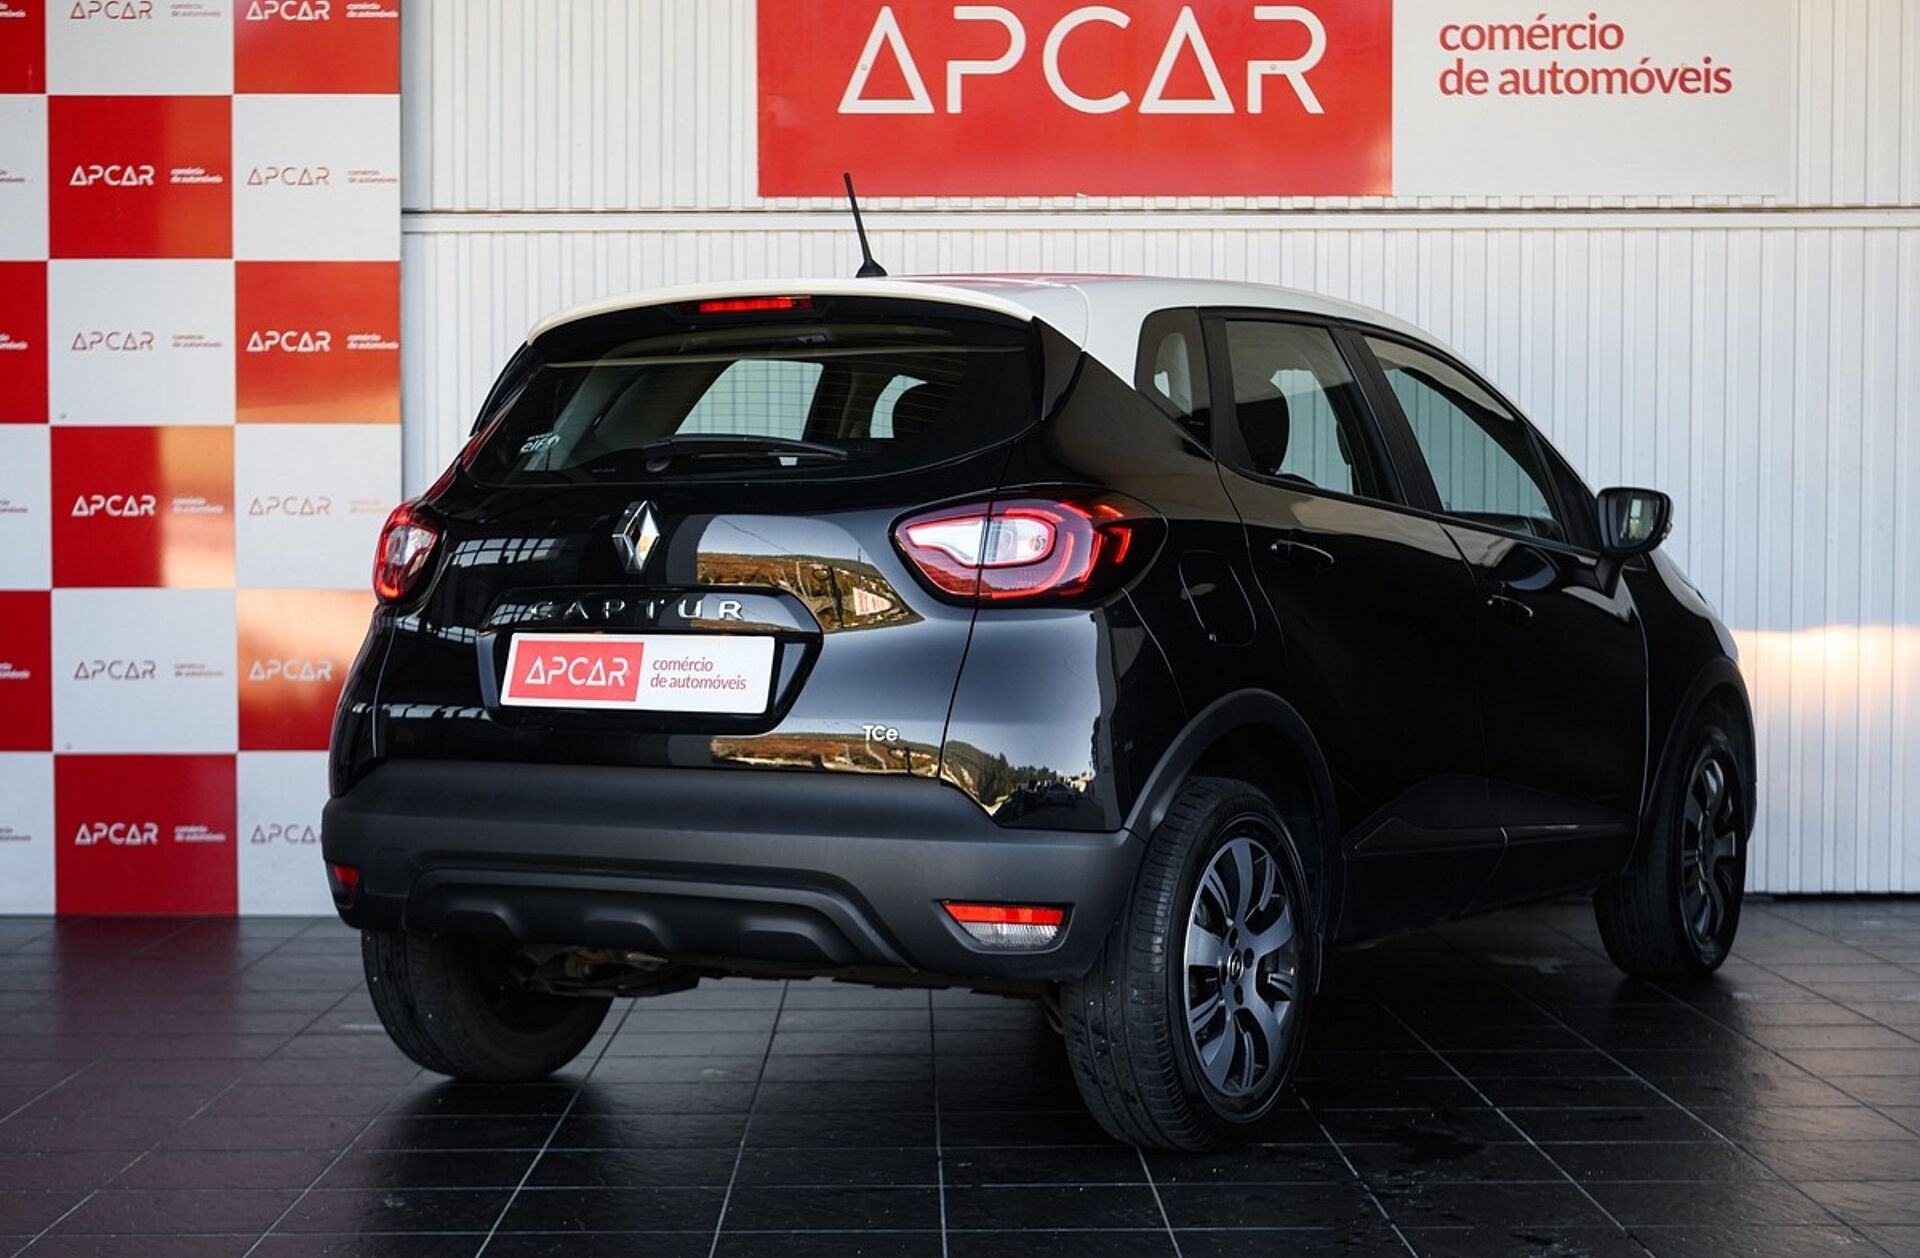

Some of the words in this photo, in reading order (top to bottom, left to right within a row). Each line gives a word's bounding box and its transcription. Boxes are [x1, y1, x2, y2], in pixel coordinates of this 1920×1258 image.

[70, 1, 153, 20] APCAR
[245, 0, 331, 20] APCAR
[1439, 13, 1625, 51] comércio
[837, 6, 1327, 114] APCAR
[1439, 58, 1489, 95] de
[1499, 56, 1732, 95] automóveis
[69, 164, 155, 187] APCAR
[247, 166, 331, 186] APCAR
[71, 331, 155, 351] APCAR
[246, 330, 332, 353] APCAR
[71, 494, 157, 517] APCAR
[248, 496, 332, 516] APCAR
[530, 599, 744, 620] CAPTUR
[74, 660, 157, 681] APCAR
[249, 658, 333, 682] APCAR
[525, 655, 629, 687] APCAR
[652, 657, 714, 672] comércio
[650, 673, 667, 688] de
[669, 674, 747, 689] automóveis
[862, 725, 899, 741] TCe
[74, 822, 159, 846] APCAR
[251, 823, 322, 844] APCA
